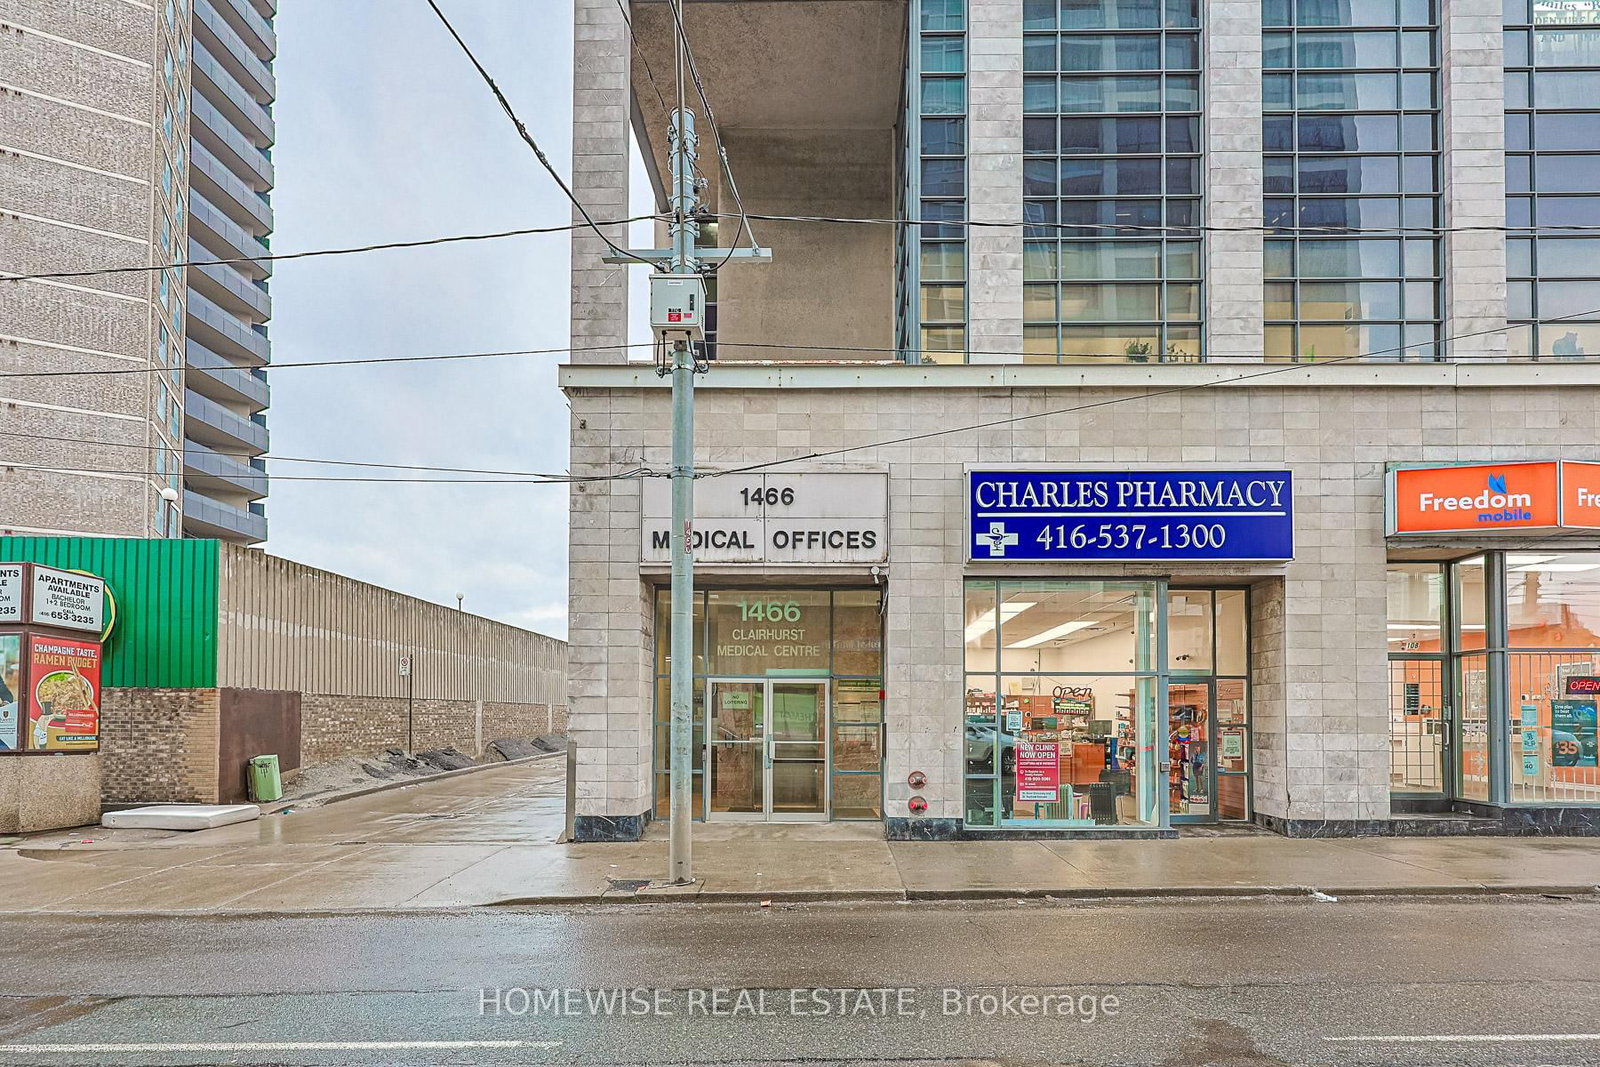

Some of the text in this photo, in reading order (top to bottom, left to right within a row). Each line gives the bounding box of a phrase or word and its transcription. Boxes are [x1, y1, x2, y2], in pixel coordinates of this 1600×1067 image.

[740, 487, 795, 506] 1466
[975, 480, 1285, 508] CHARLES PHARMACY
[1419, 489, 1531, 512] Freedom
[1478, 509, 1531, 522] mobile
[652, 530, 877, 549] MDICAL OFFICES
[1036, 523, 1226, 550] 416-537-1300
[38, 574, 100, 593] APARTMENTS
[47, 584, 91, 599] AVAILABLE
[51, 593, 86, 605] BACHELOR
[59, 601, 91, 612] BEDROOM
[736, 600, 801, 622] 1466
[50, 611, 94, 625] 653-3235
[732, 629, 806, 641] CLAIRHURST
[34, 643, 75, 656] CHAMPAGNE
[717, 645, 768, 657] MEDICAL
[774, 645, 821, 657] CENTRE
[34, 653, 98, 669] RAMEN BUDGET
[1570, 681, 1600, 691] OPEN
